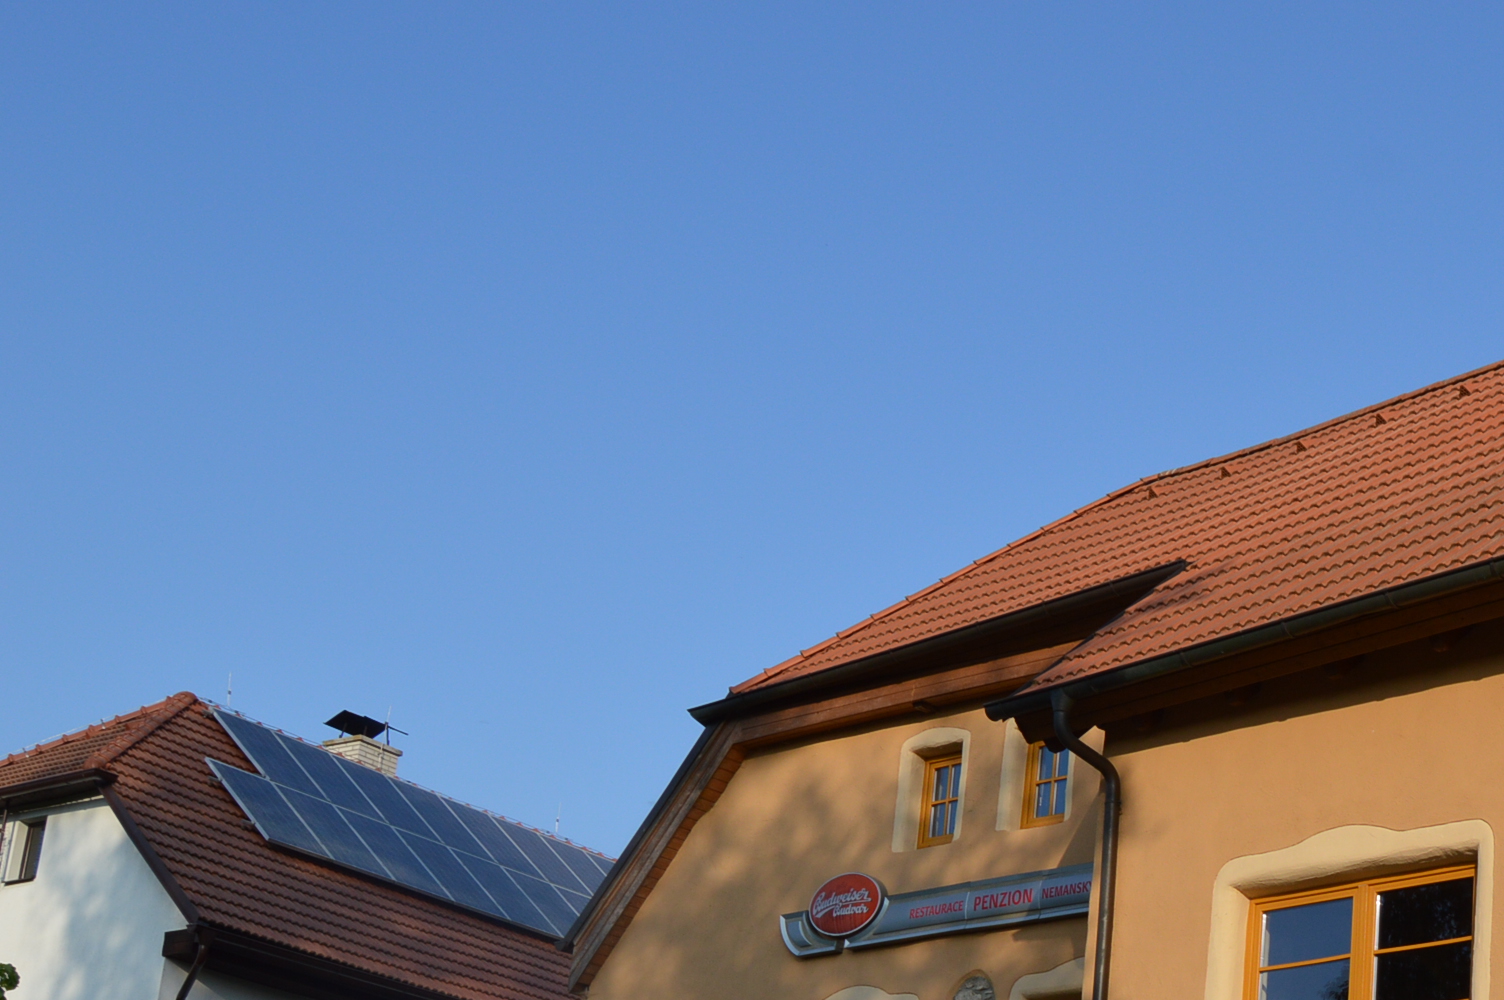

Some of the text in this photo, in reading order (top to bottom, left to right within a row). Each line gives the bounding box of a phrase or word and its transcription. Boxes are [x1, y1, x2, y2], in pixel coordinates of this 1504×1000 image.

[813, 888, 872, 918] Budweiser
[833, 903, 869, 917] Budvar
[909, 901, 964, 919] RESTAURACE
[973, 888, 1033, 911] PENZION
